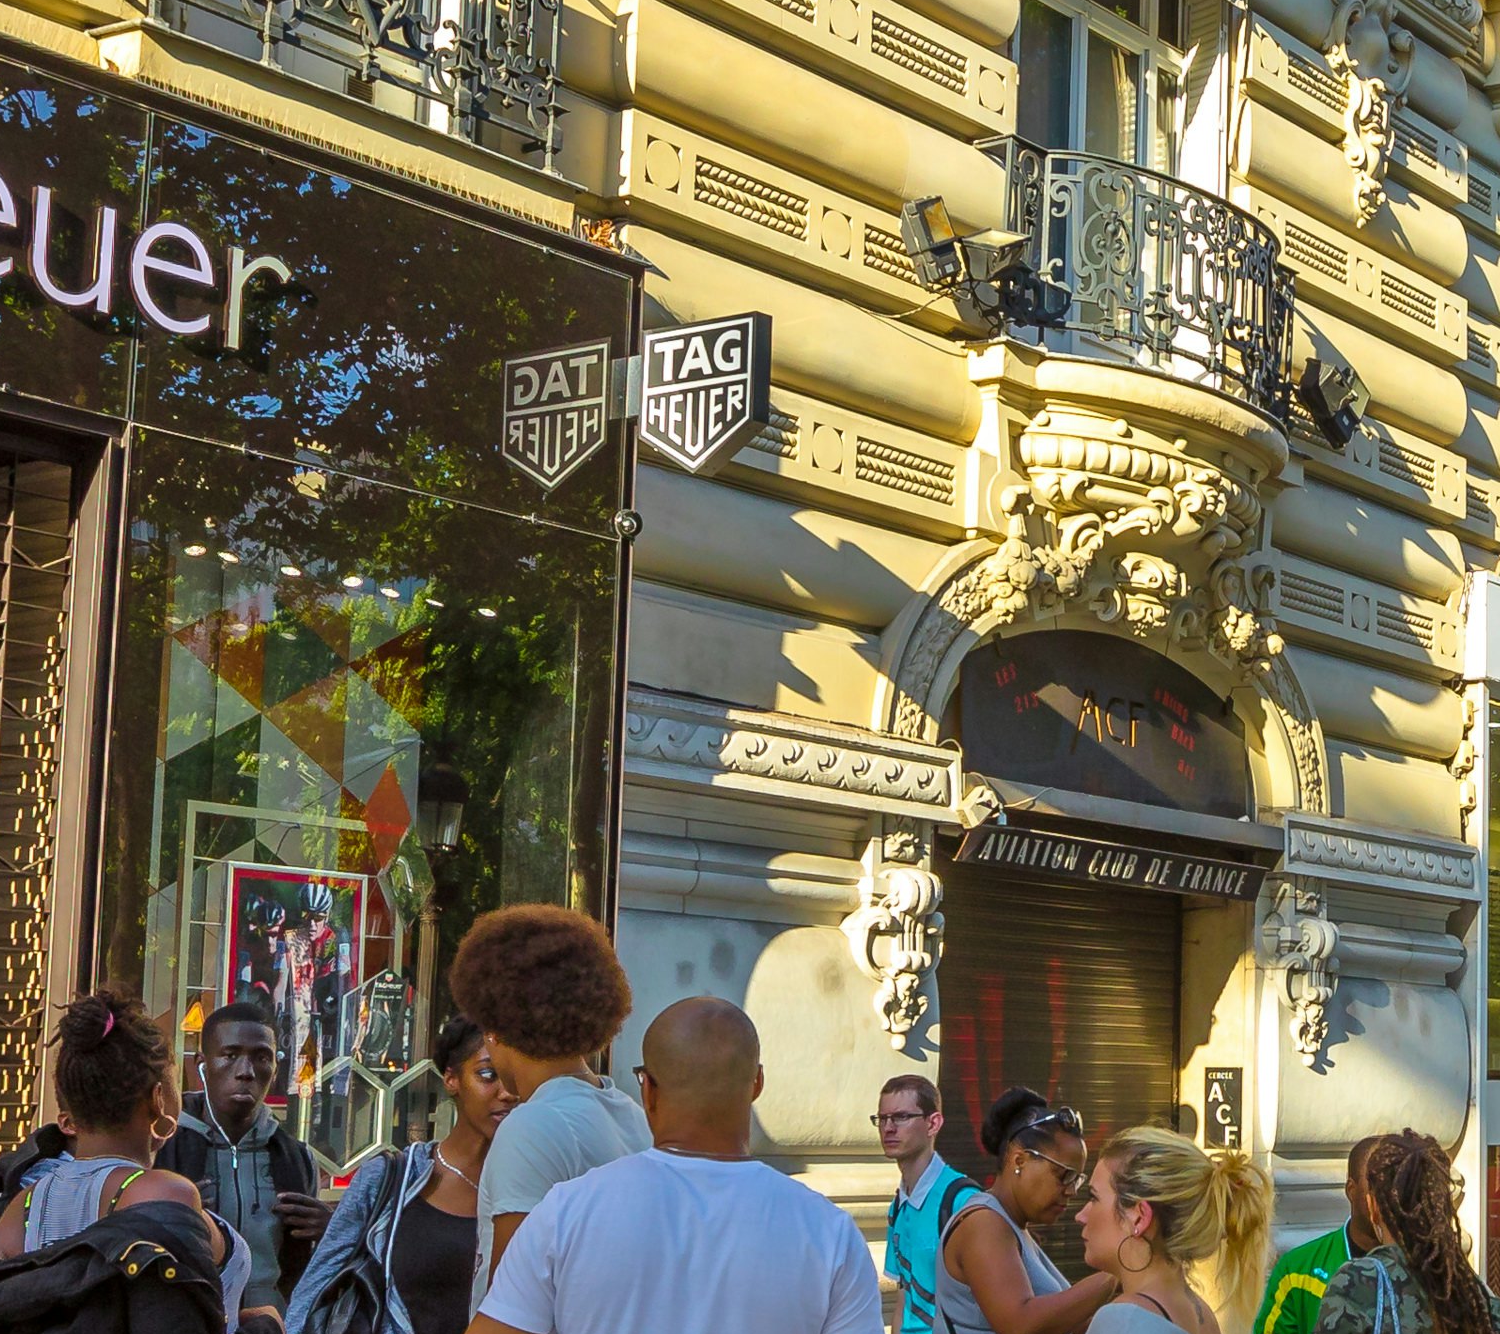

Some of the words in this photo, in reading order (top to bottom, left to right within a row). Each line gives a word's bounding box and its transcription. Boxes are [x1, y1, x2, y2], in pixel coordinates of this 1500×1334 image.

[653, 329, 742, 382] TAG
[648, 383, 744, 456] HEUER
[978, 833, 1081, 871] AVIATION
[1088, 849, 1139, 880] CLUB
[1145, 857, 1173, 886] DE
[1179, 863, 1249, 896] FRANCE
